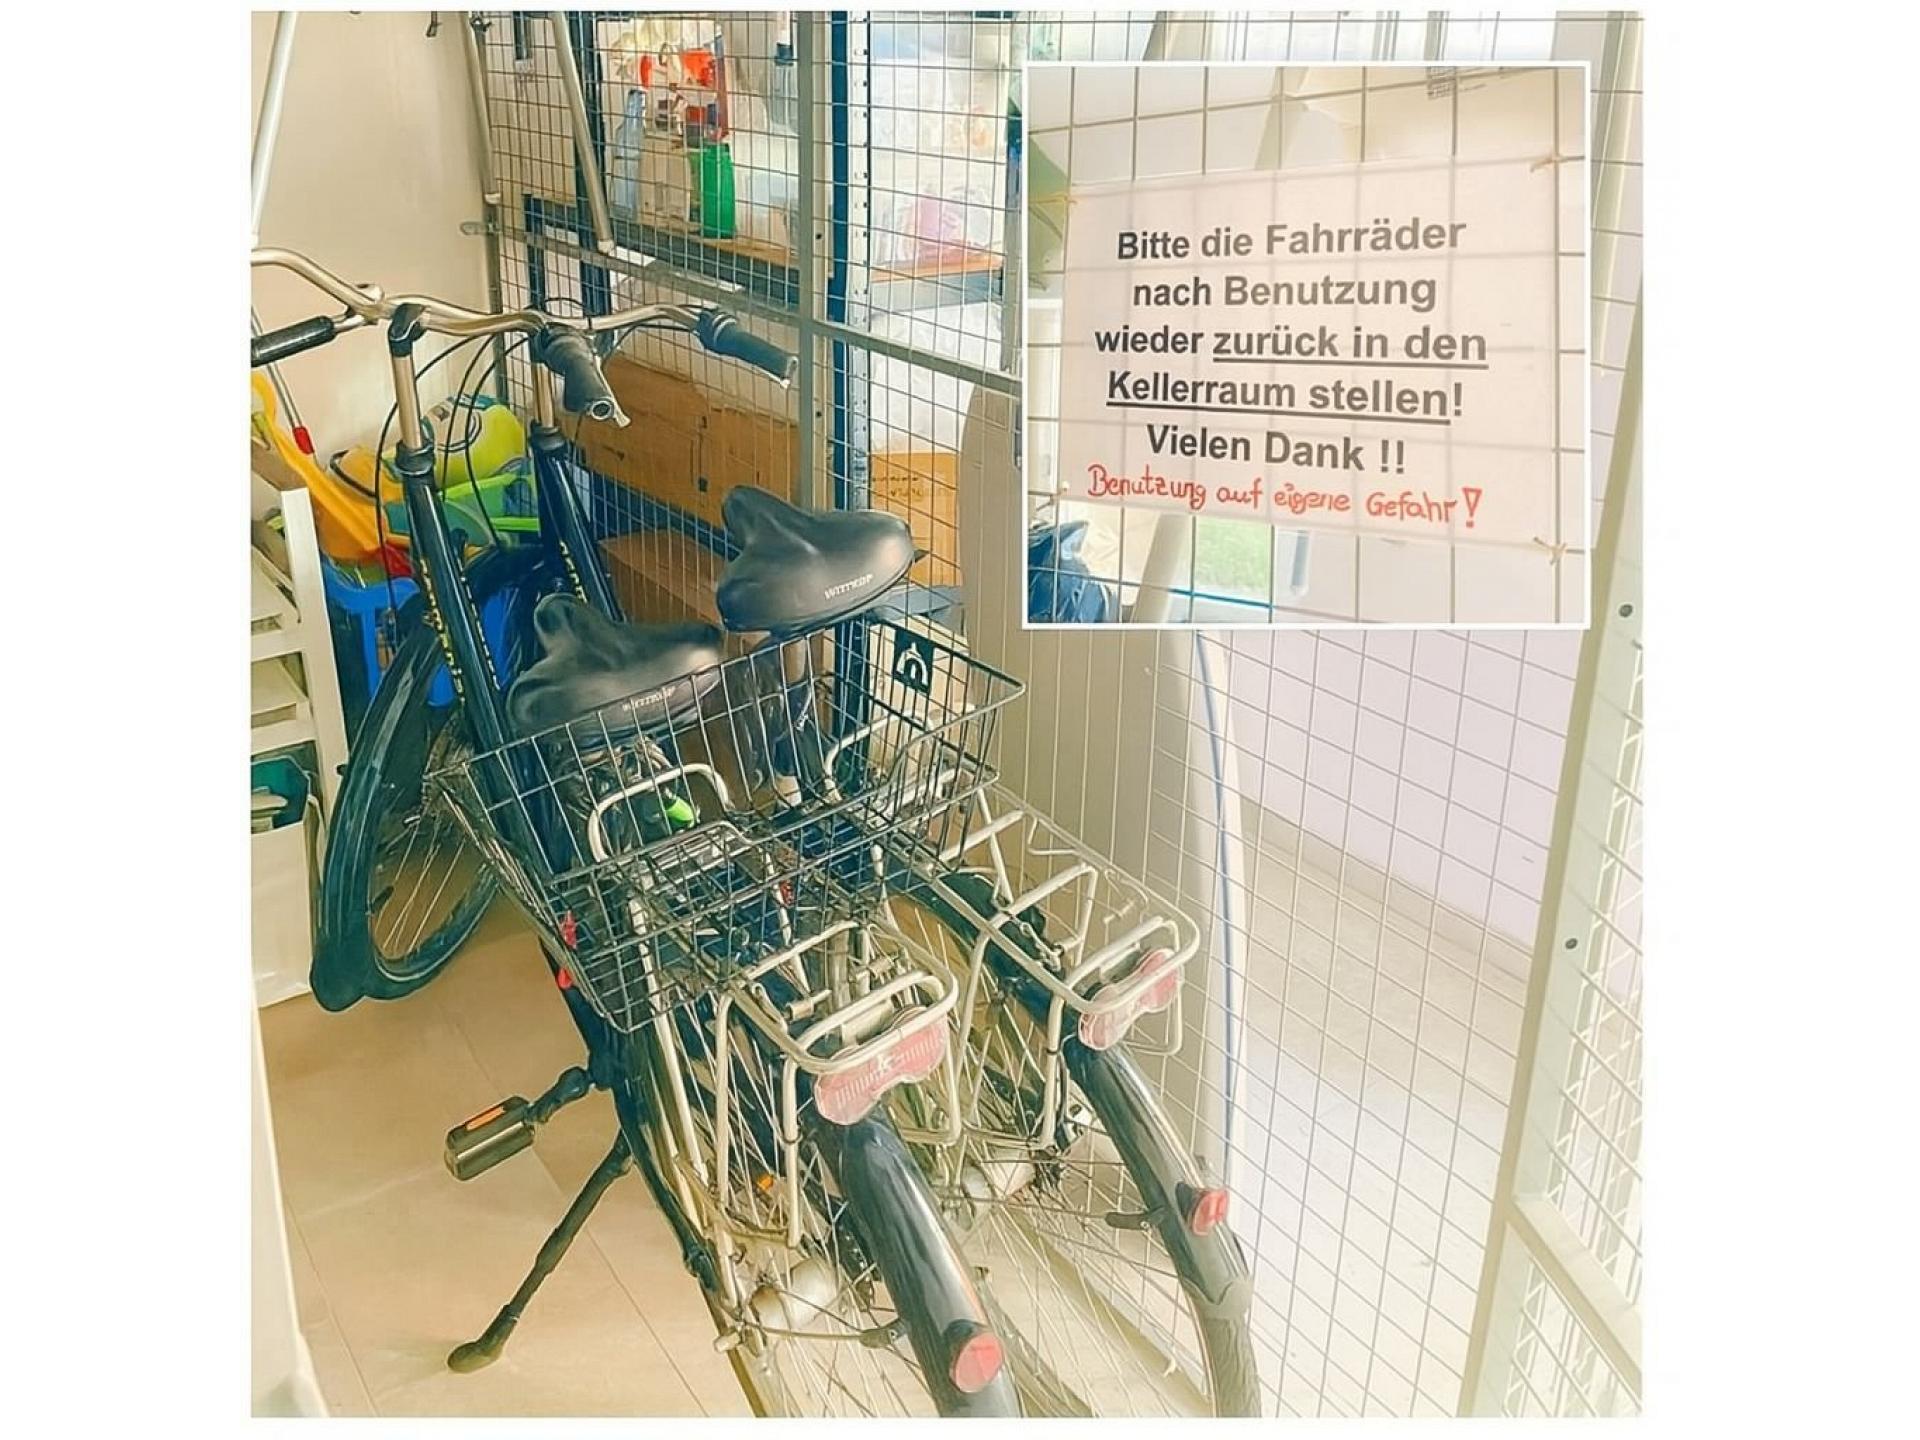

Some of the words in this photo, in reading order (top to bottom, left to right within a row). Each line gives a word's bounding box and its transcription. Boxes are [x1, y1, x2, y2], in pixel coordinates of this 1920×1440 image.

[1117, 230, 1190, 260] Bitte
[1201, 227, 1253, 257] die
[1266, 216, 1467, 255] Fahrräder
[1133, 277, 1211, 306] nach
[1224, 275, 1436, 312] Benutzung
[1095, 325, 1204, 354] wieder
[1213, 325, 1339, 357] zurück
[1353, 326, 1388, 358] in
[1404, 326, 1487, 361] den
[1108, 371, 1296, 408] Kellerraum
[1309, 379, 1462, 417] stellen!
[1147, 424, 1251, 462] Vielen
[1265, 431, 1365, 471] Dank
[1380, 439, 1405, 474] !!
[1088, 464, 1207, 510] Benutzung
[1217, 478, 1263, 509] auf
[1275, 483, 1350, 514] eigene
[1367, 487, 1483, 528] Gefahr!
